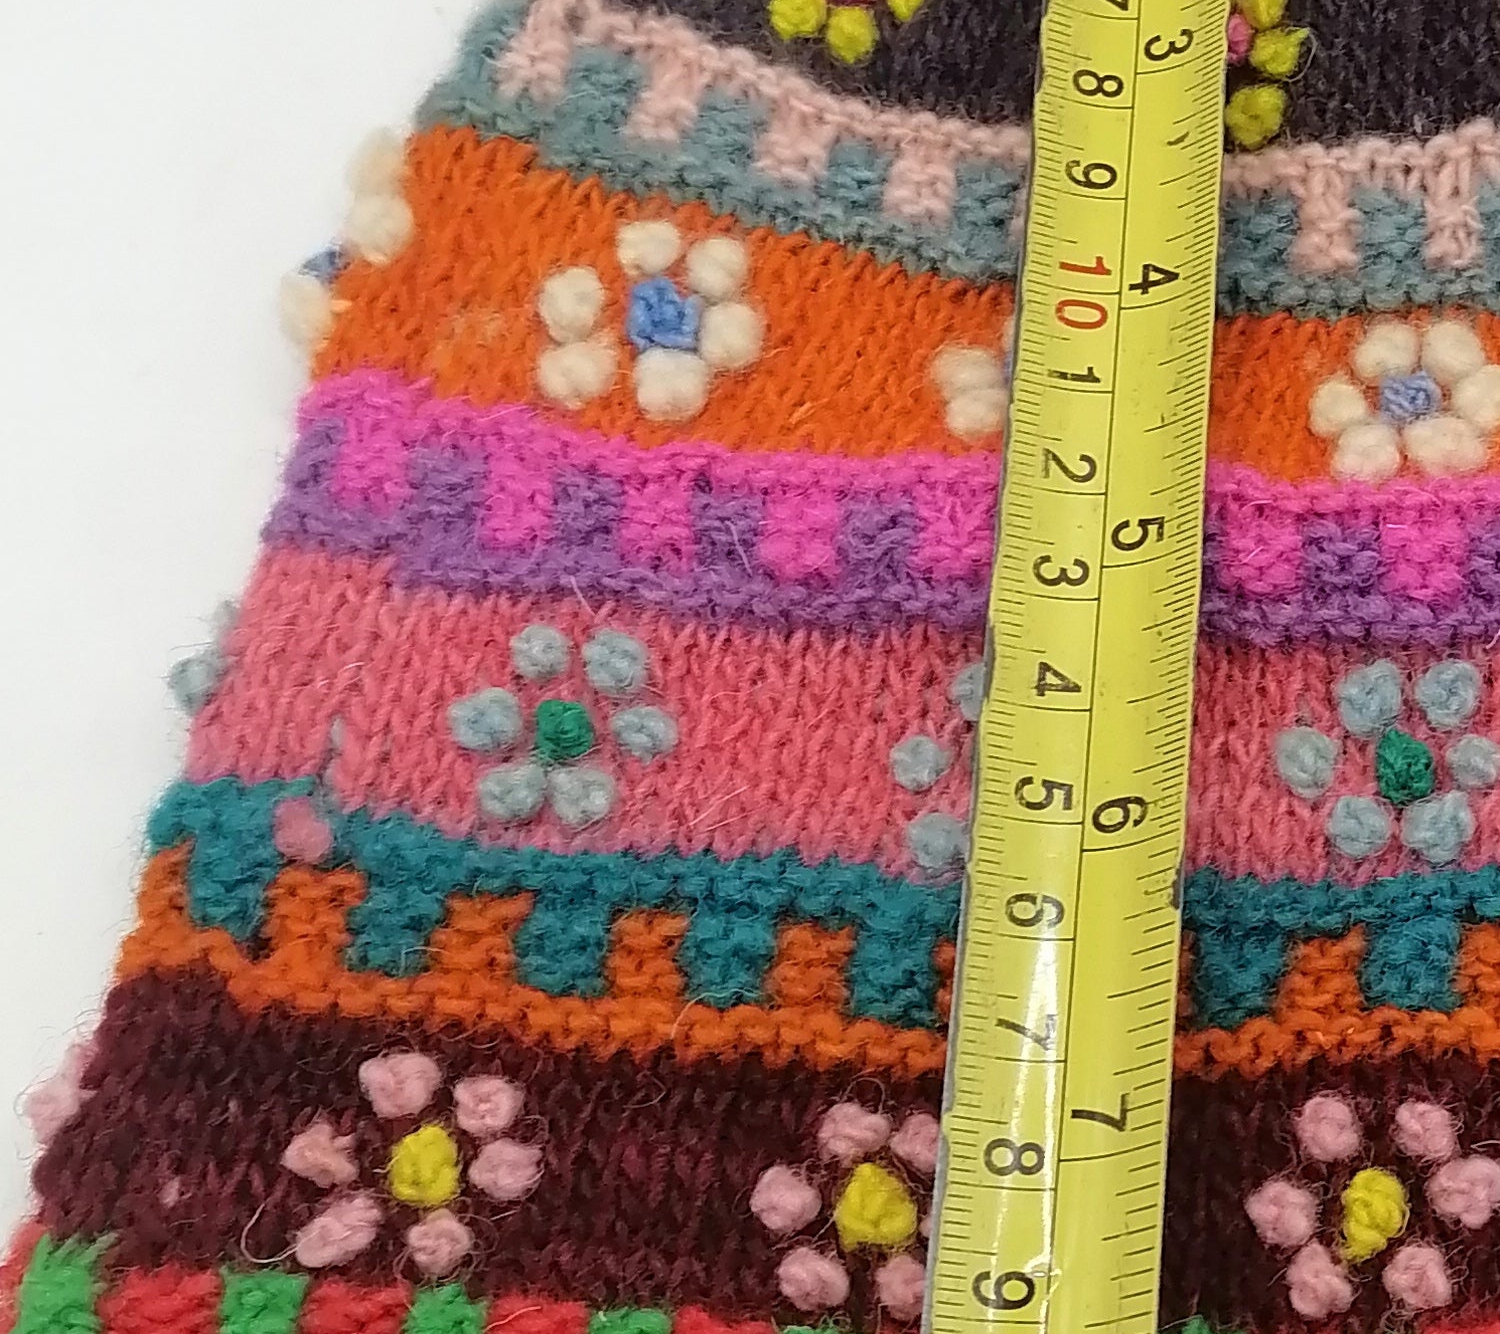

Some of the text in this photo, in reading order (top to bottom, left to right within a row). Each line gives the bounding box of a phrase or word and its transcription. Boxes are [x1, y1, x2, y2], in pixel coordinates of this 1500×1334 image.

[1144, 28, 1194, 62] 3
[1072, 69, 1124, 98] 8
[1065, 159, 1118, 190] 9
[1128, 263, 1180, 295] 4
[1048, 366, 1101, 383] 1
[1042, 448, 1097, 483] 2
[1111, 516, 1165, 551] 5
[1033, 555, 1089, 587] 3
[1034, 661, 1082, 697] 4
[1014, 776, 1074, 811] 5
[1092, 795, 1149, 833] 6
[1005, 892, 1065, 928] 6
[995, 1014, 1058, 1051] 7
[1071, 1092, 1130, 1131] 7
[984, 1137, 1044, 1176] 8
[972, 1270, 1035, 1310] 9
